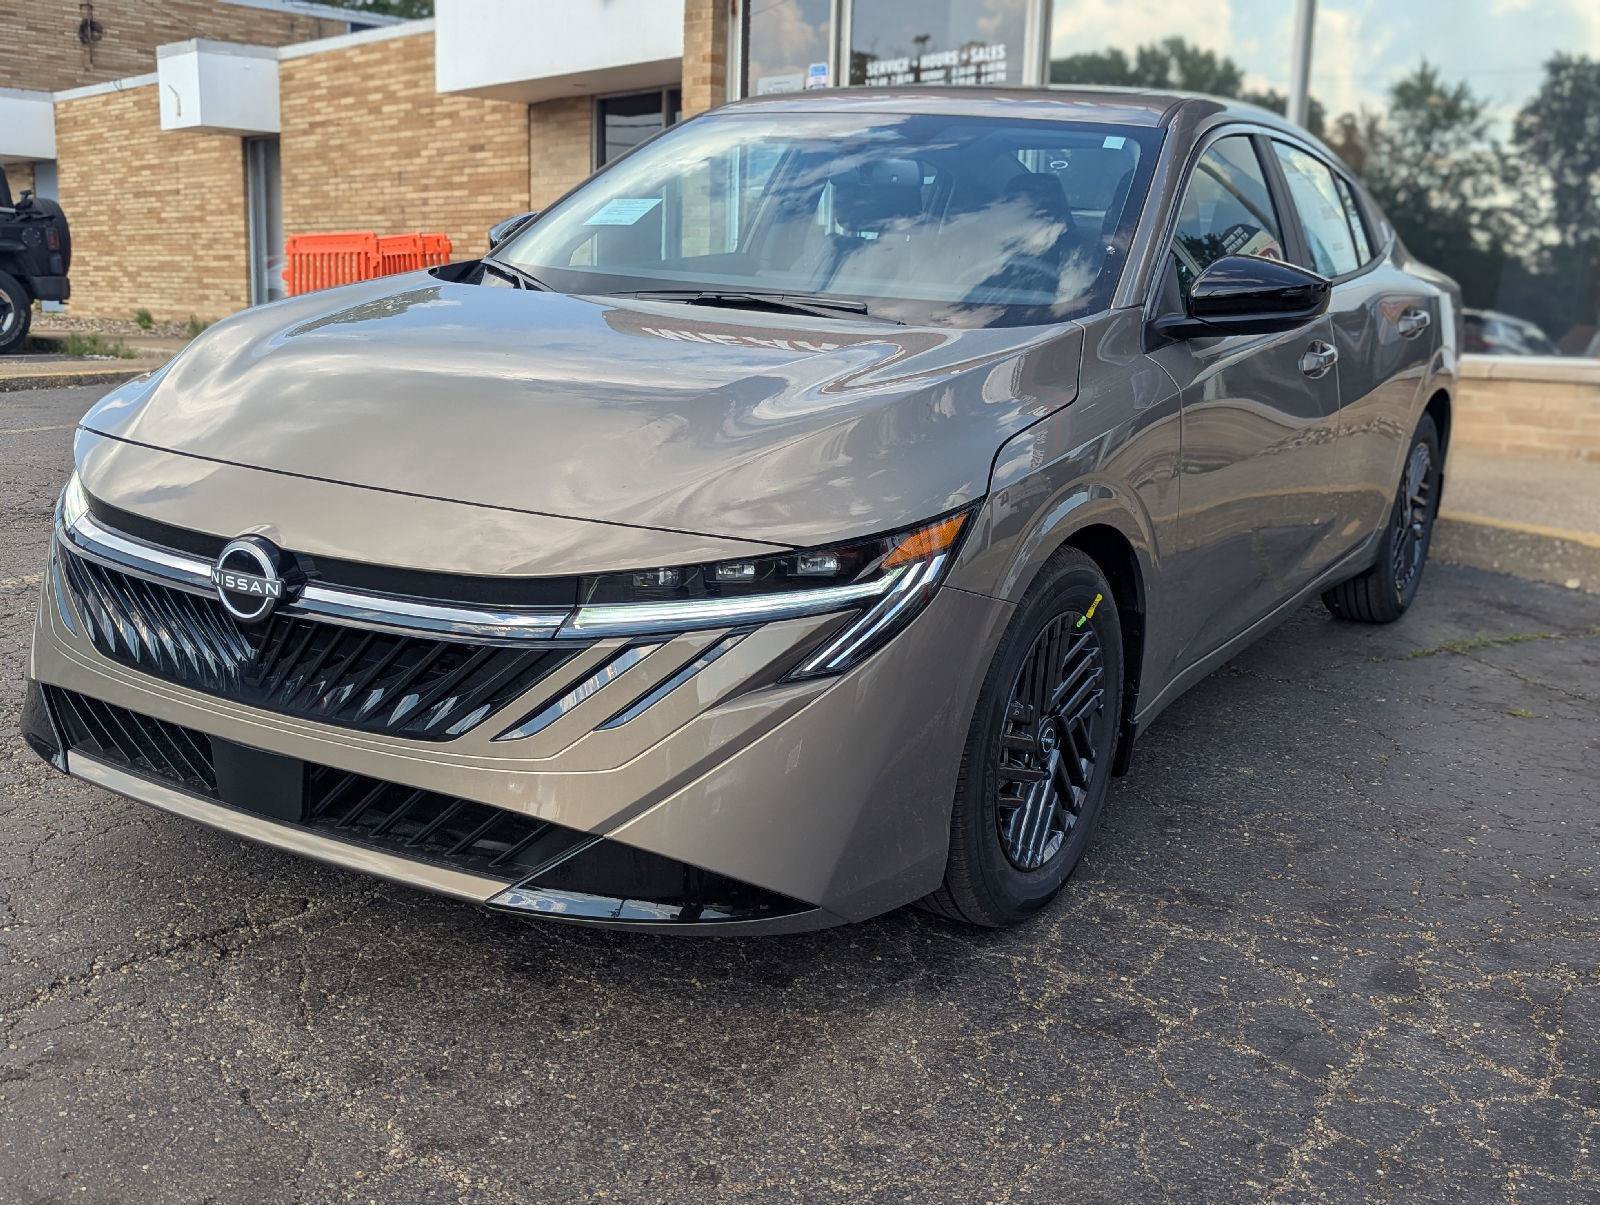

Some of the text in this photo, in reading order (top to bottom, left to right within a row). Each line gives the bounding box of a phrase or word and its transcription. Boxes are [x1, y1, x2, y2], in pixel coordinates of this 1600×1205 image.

[866, 58, 909, 77] SERVICE
[920, 50, 958, 69] HOURS
[970, 44, 1006, 63] SALES
[211, 570, 278, 595] NISSAN
